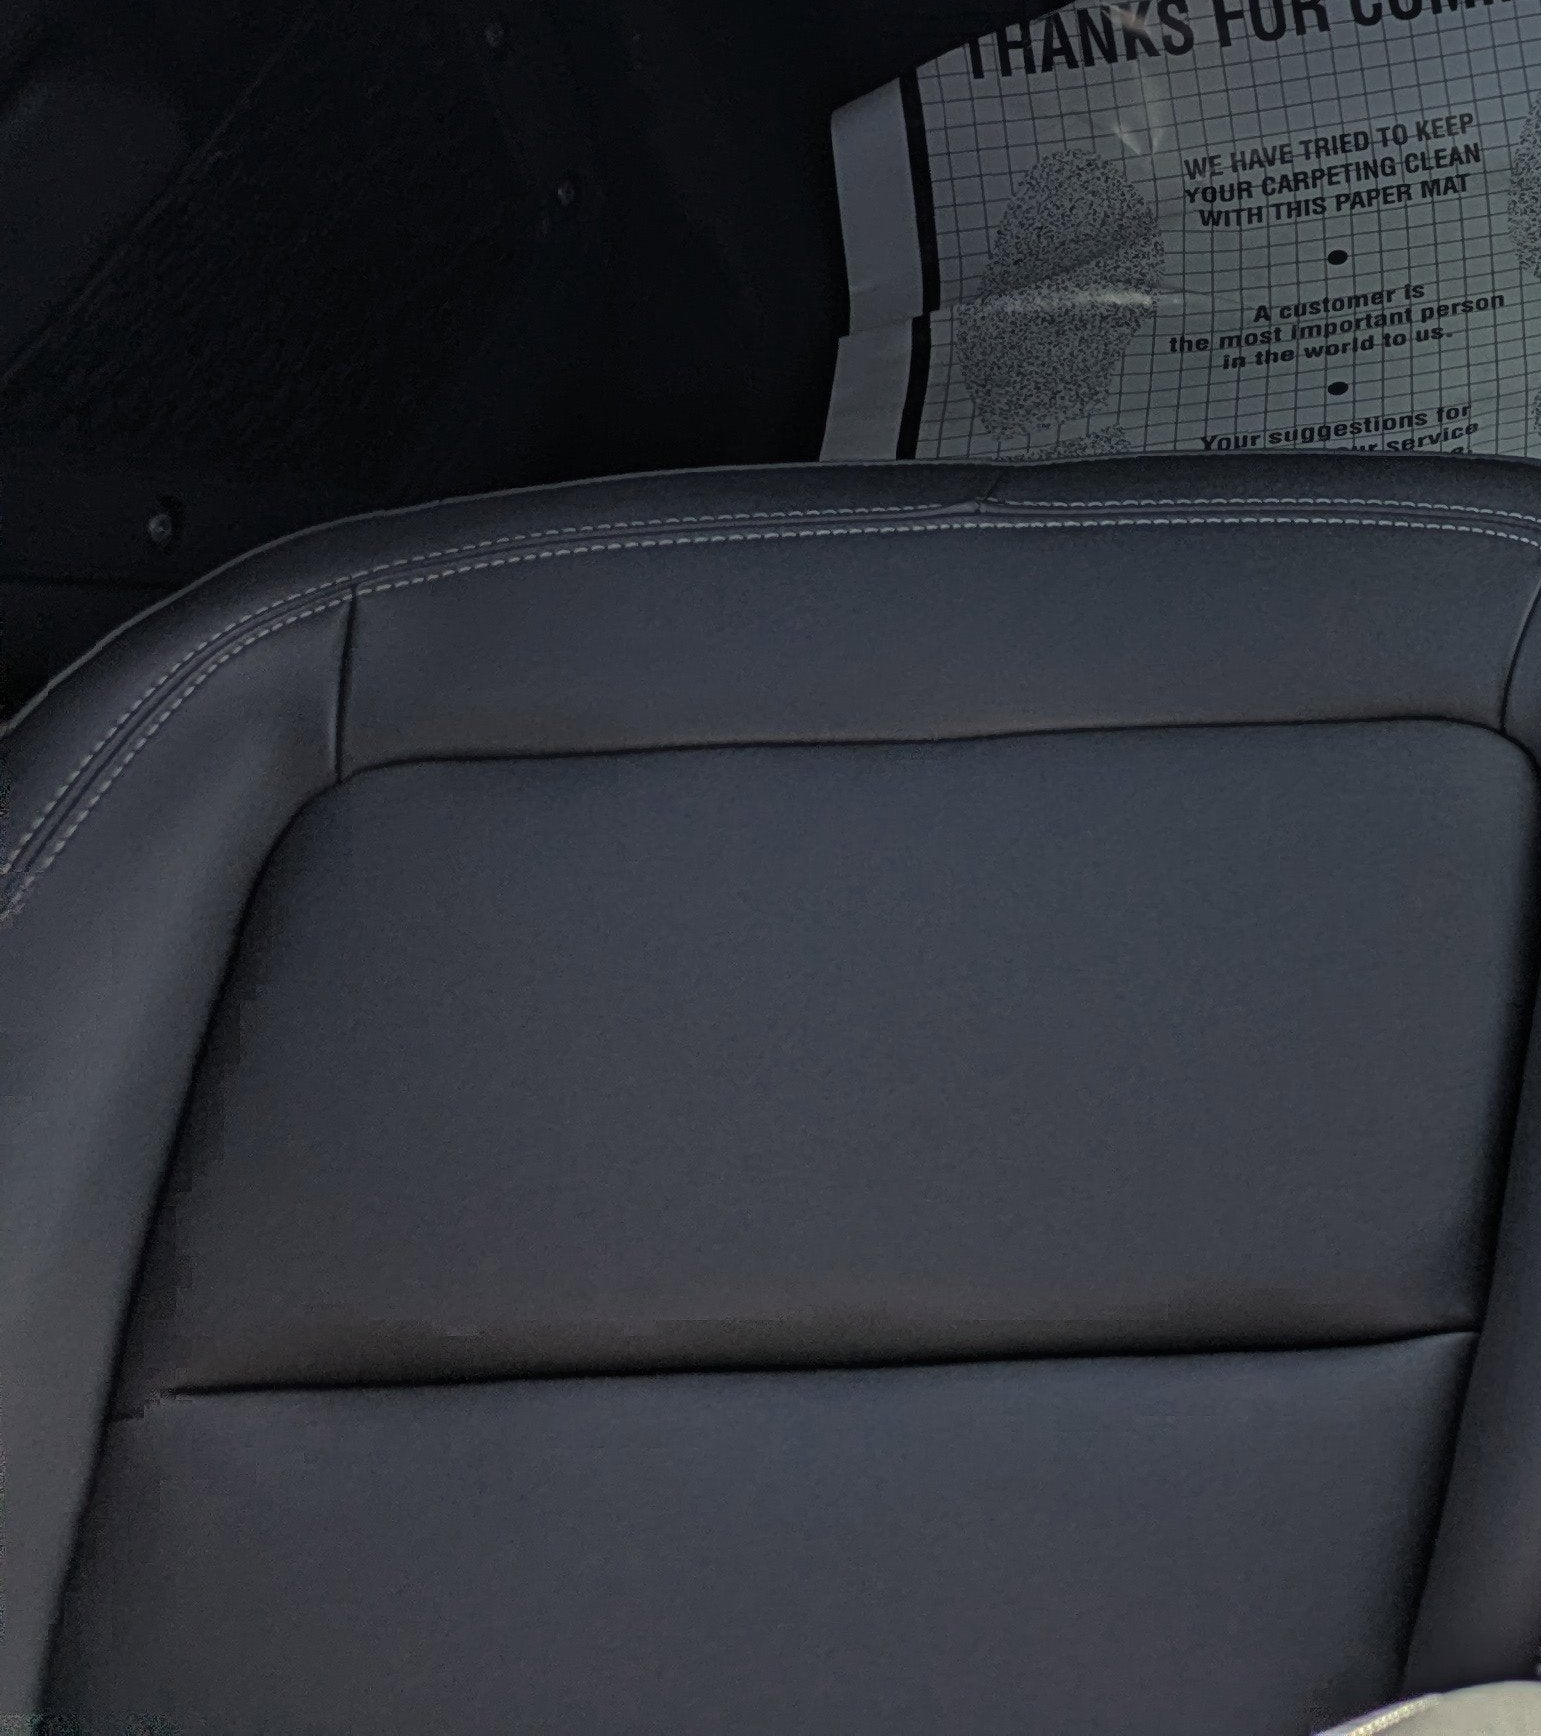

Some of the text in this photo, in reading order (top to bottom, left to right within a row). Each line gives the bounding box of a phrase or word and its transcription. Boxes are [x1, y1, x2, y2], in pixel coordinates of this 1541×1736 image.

[1184, 112, 1474, 180] WE HAVE TRIED TO KEEP
[1184, 142, 1482, 204] YOUR CARPETING CLEAN
[1199, 173, 1470, 228] WITH THIS PAPER MAT
[1170, 294, 1505, 353] the most important person
[1253, 283, 1425, 323] A customer is
[1222, 326, 1453, 370] in the world to us.
[1201, 403, 1472, 452] Your suggestions for
[1386, 421, 1479, 452] service
